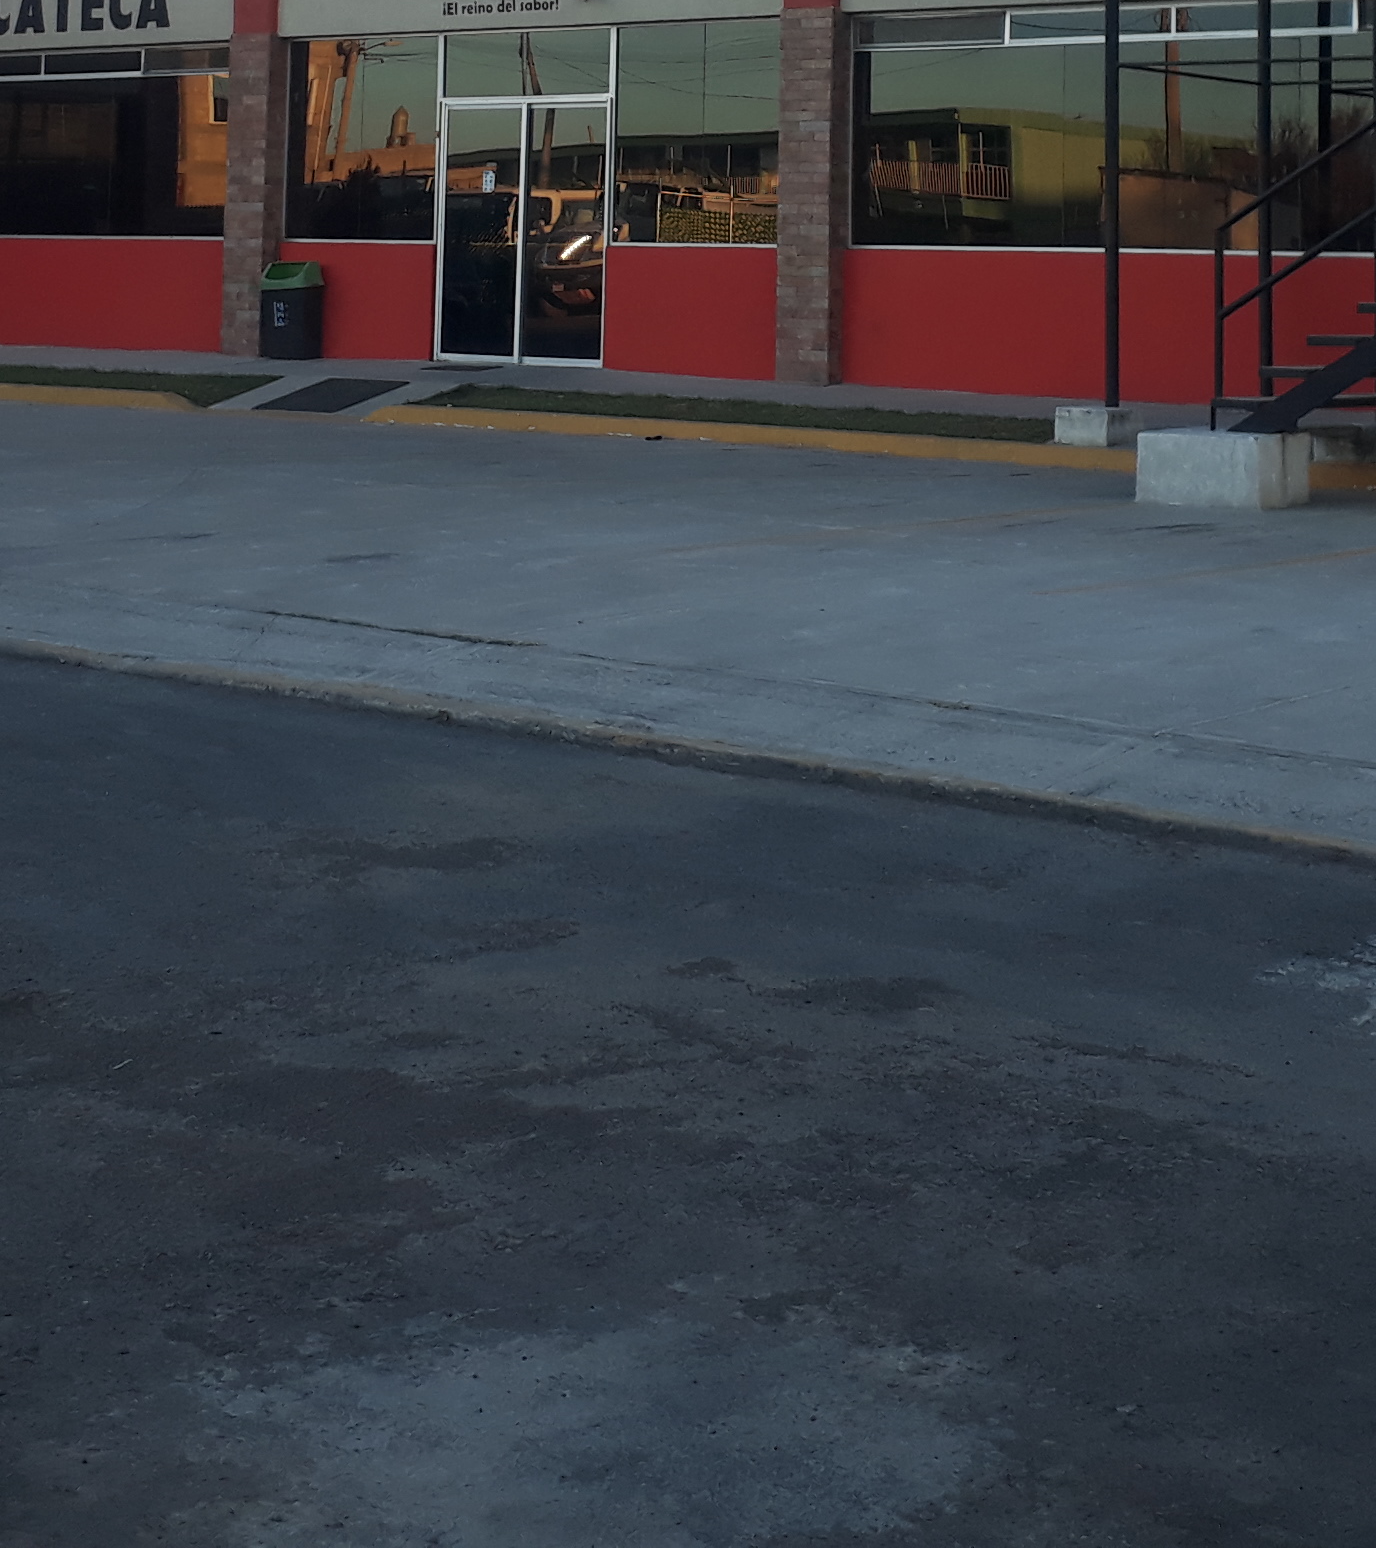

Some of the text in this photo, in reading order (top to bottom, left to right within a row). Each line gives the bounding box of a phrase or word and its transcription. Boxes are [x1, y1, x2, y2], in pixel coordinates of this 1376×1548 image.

[442, 2, 458, 15] ¡El
[462, 1, 493, 14] reino
[497, 0, 516, 13] del
